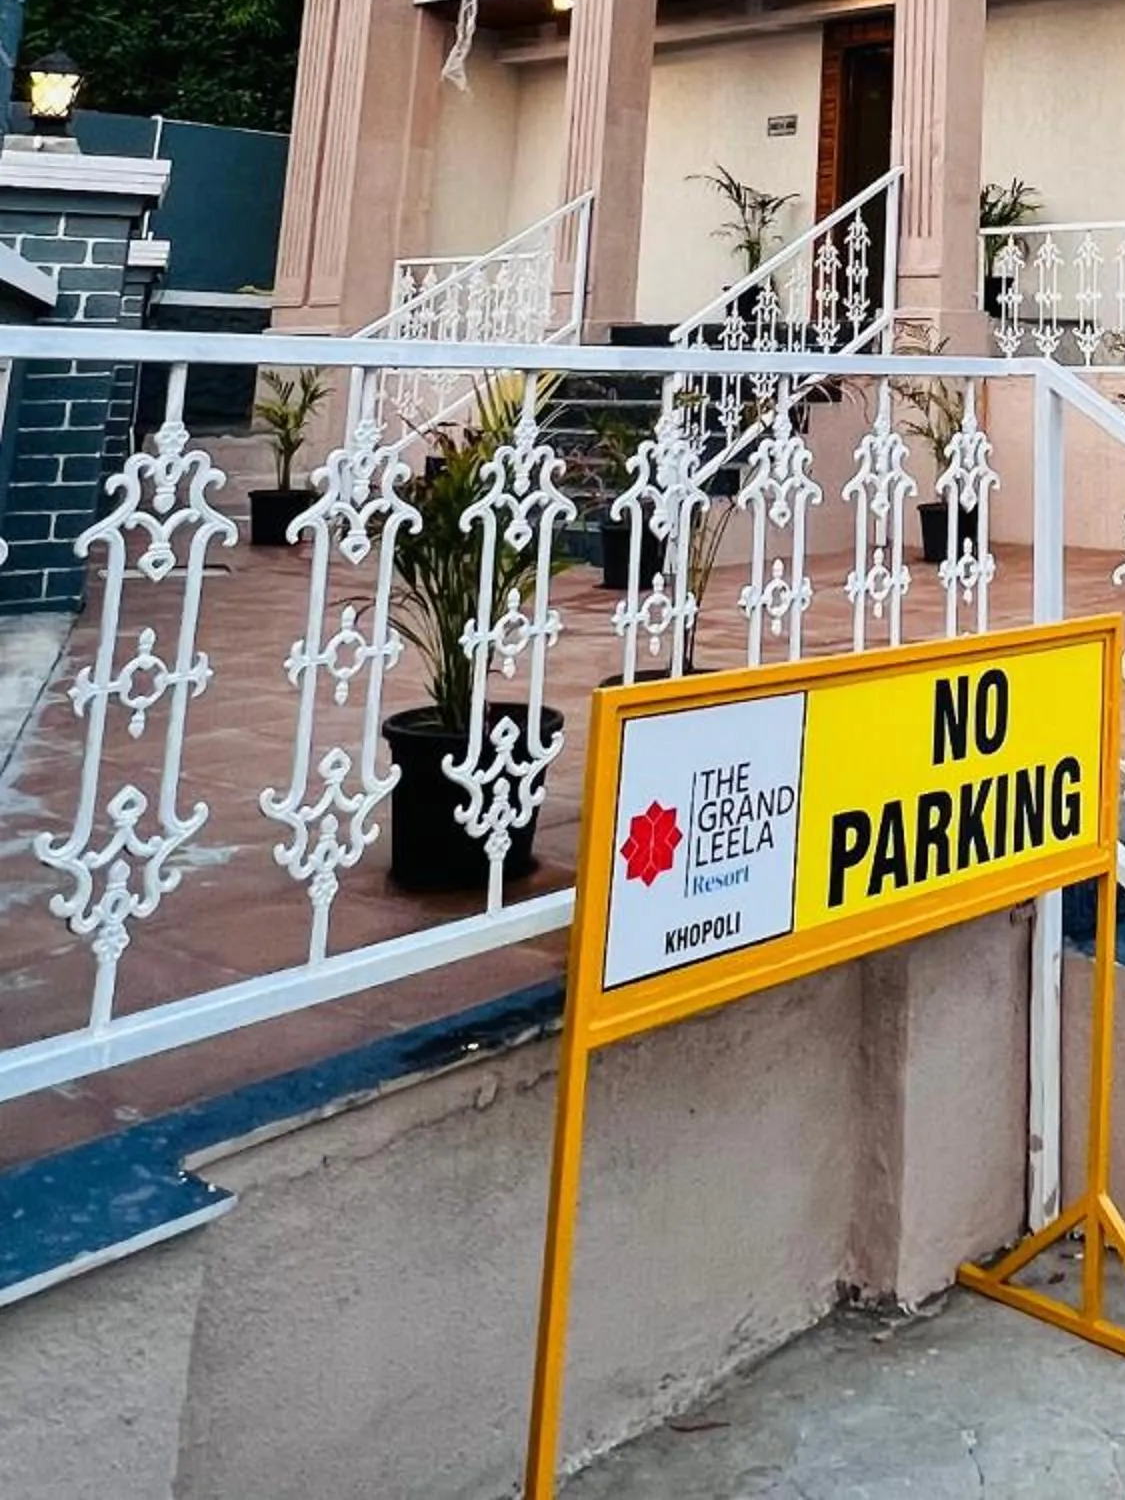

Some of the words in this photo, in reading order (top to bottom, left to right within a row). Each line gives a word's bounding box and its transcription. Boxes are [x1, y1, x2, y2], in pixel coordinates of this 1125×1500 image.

[932, 668, 1009, 766] NO
[701, 761, 751, 798] THE
[699, 784, 795, 833] GRAND
[827, 755, 1081, 909] PARKING
[695, 820, 775, 868] LEELA
[692, 863, 750, 897] Resort
[665, 911, 741, 955] KHOPOLI
